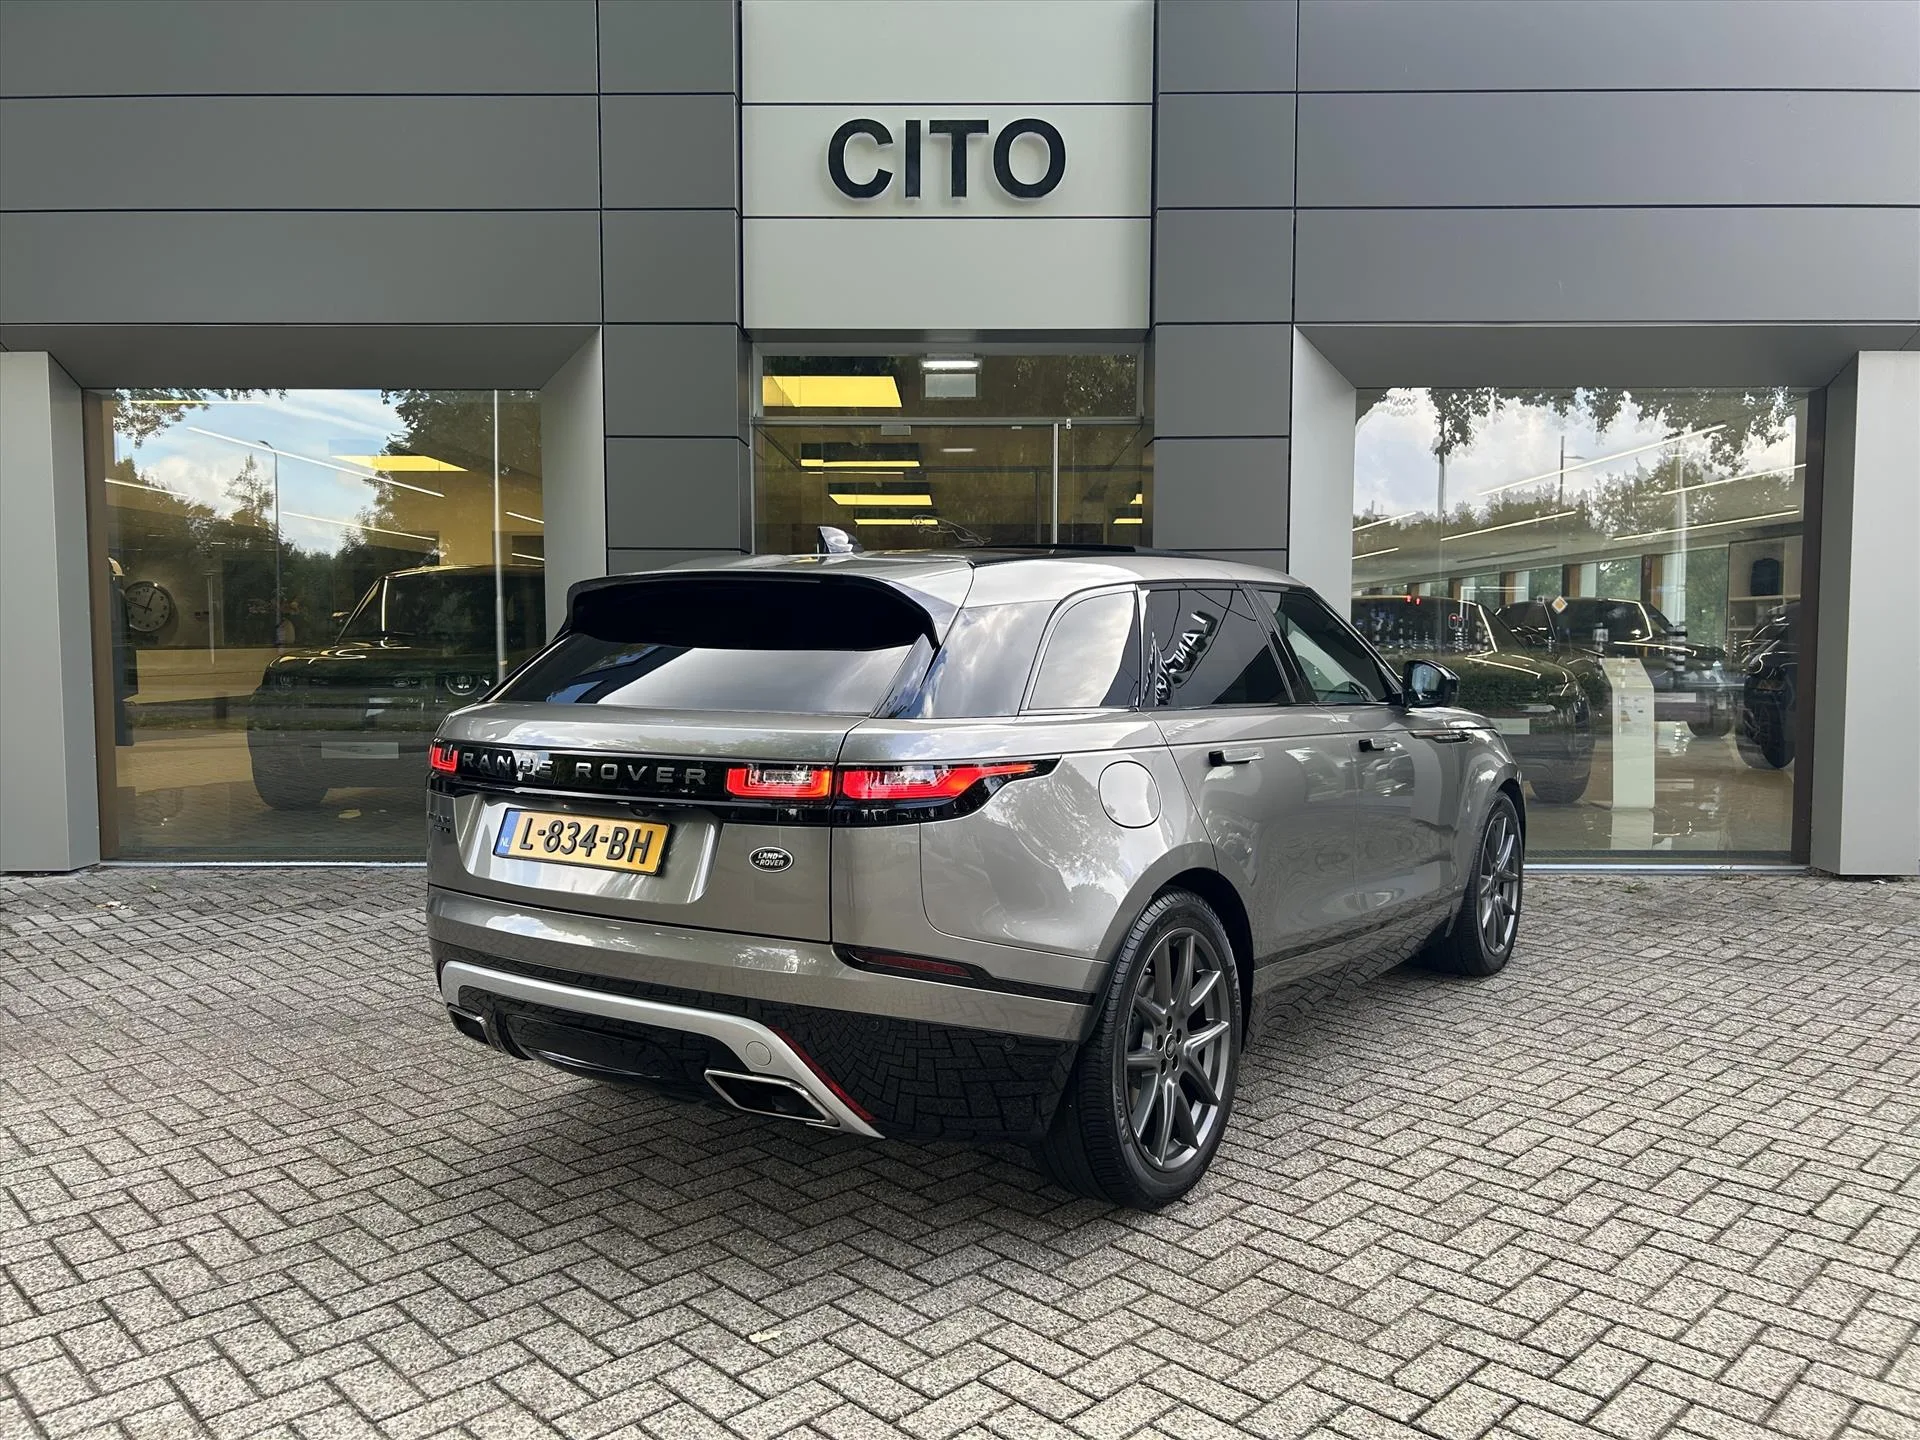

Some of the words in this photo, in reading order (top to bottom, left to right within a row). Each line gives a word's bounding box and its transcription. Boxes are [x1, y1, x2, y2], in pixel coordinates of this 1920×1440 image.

[828, 118, 1066, 199] CITO
[462, 752, 554, 776] RANGE
[575, 762, 706, 785] ROVER
[500, 836, 510, 848] NL
[519, 817, 653, 865] L-834-BH
